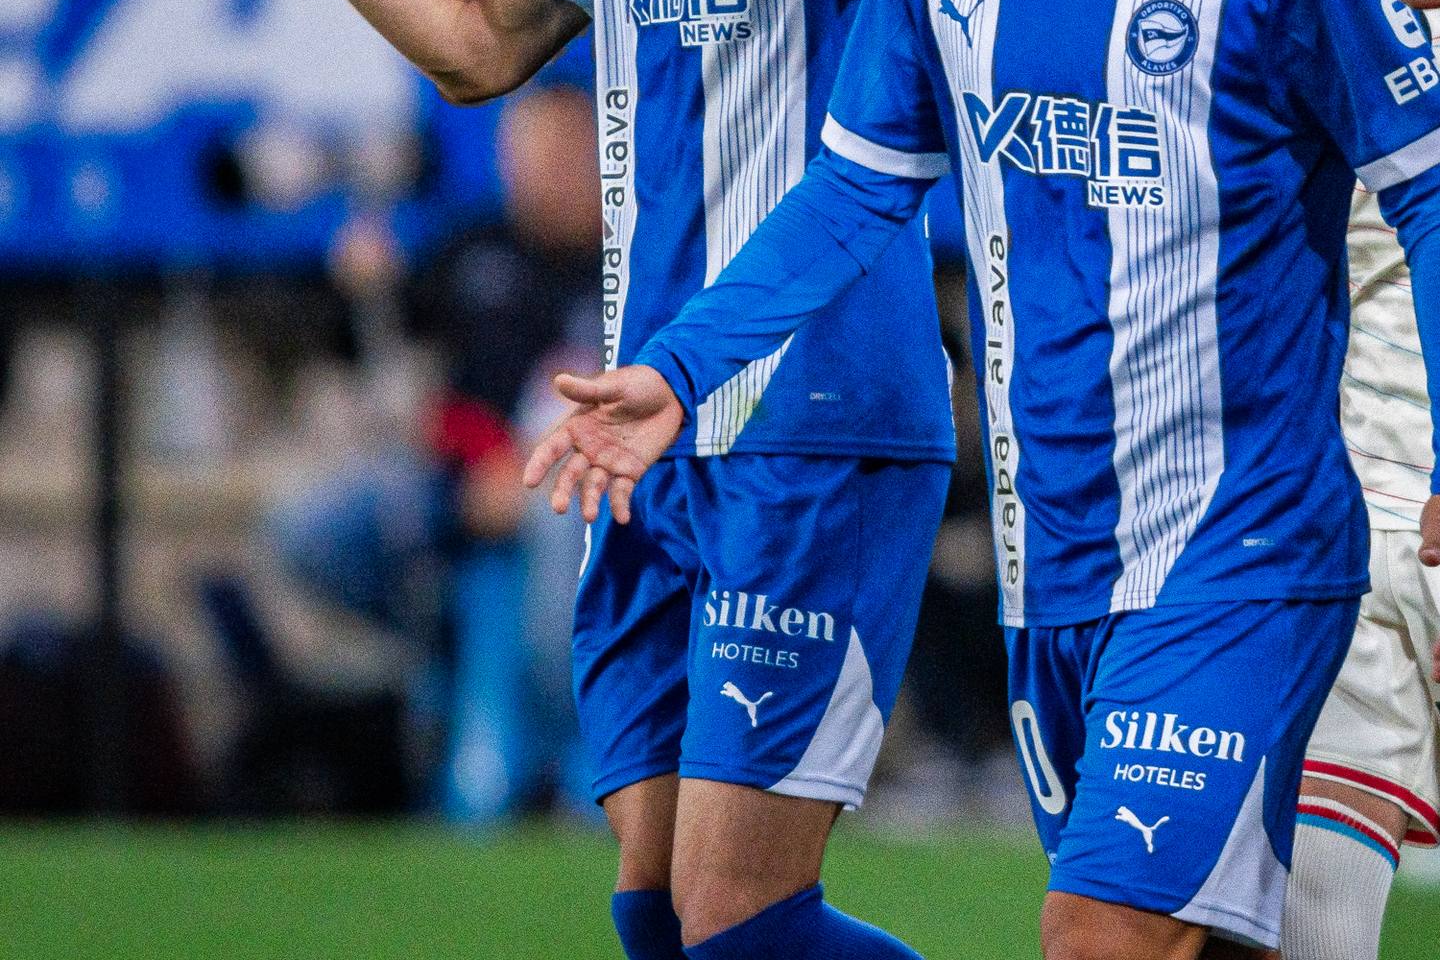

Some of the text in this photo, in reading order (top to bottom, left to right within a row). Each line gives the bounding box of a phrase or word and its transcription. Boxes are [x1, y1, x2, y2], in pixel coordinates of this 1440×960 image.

[1140, 1, 1188, 20] DEPORTIVO
[682, 21, 751, 42] NEWS
[1090, 184, 1165, 206] NEWS
[994, 435, 1018, 586] araba
[703, 589, 835, 643] Silken
[711, 642, 800, 668] HOTELES
[1100, 710, 1246, 763] Silken
[1113, 763, 1207, 791] HOTELES
